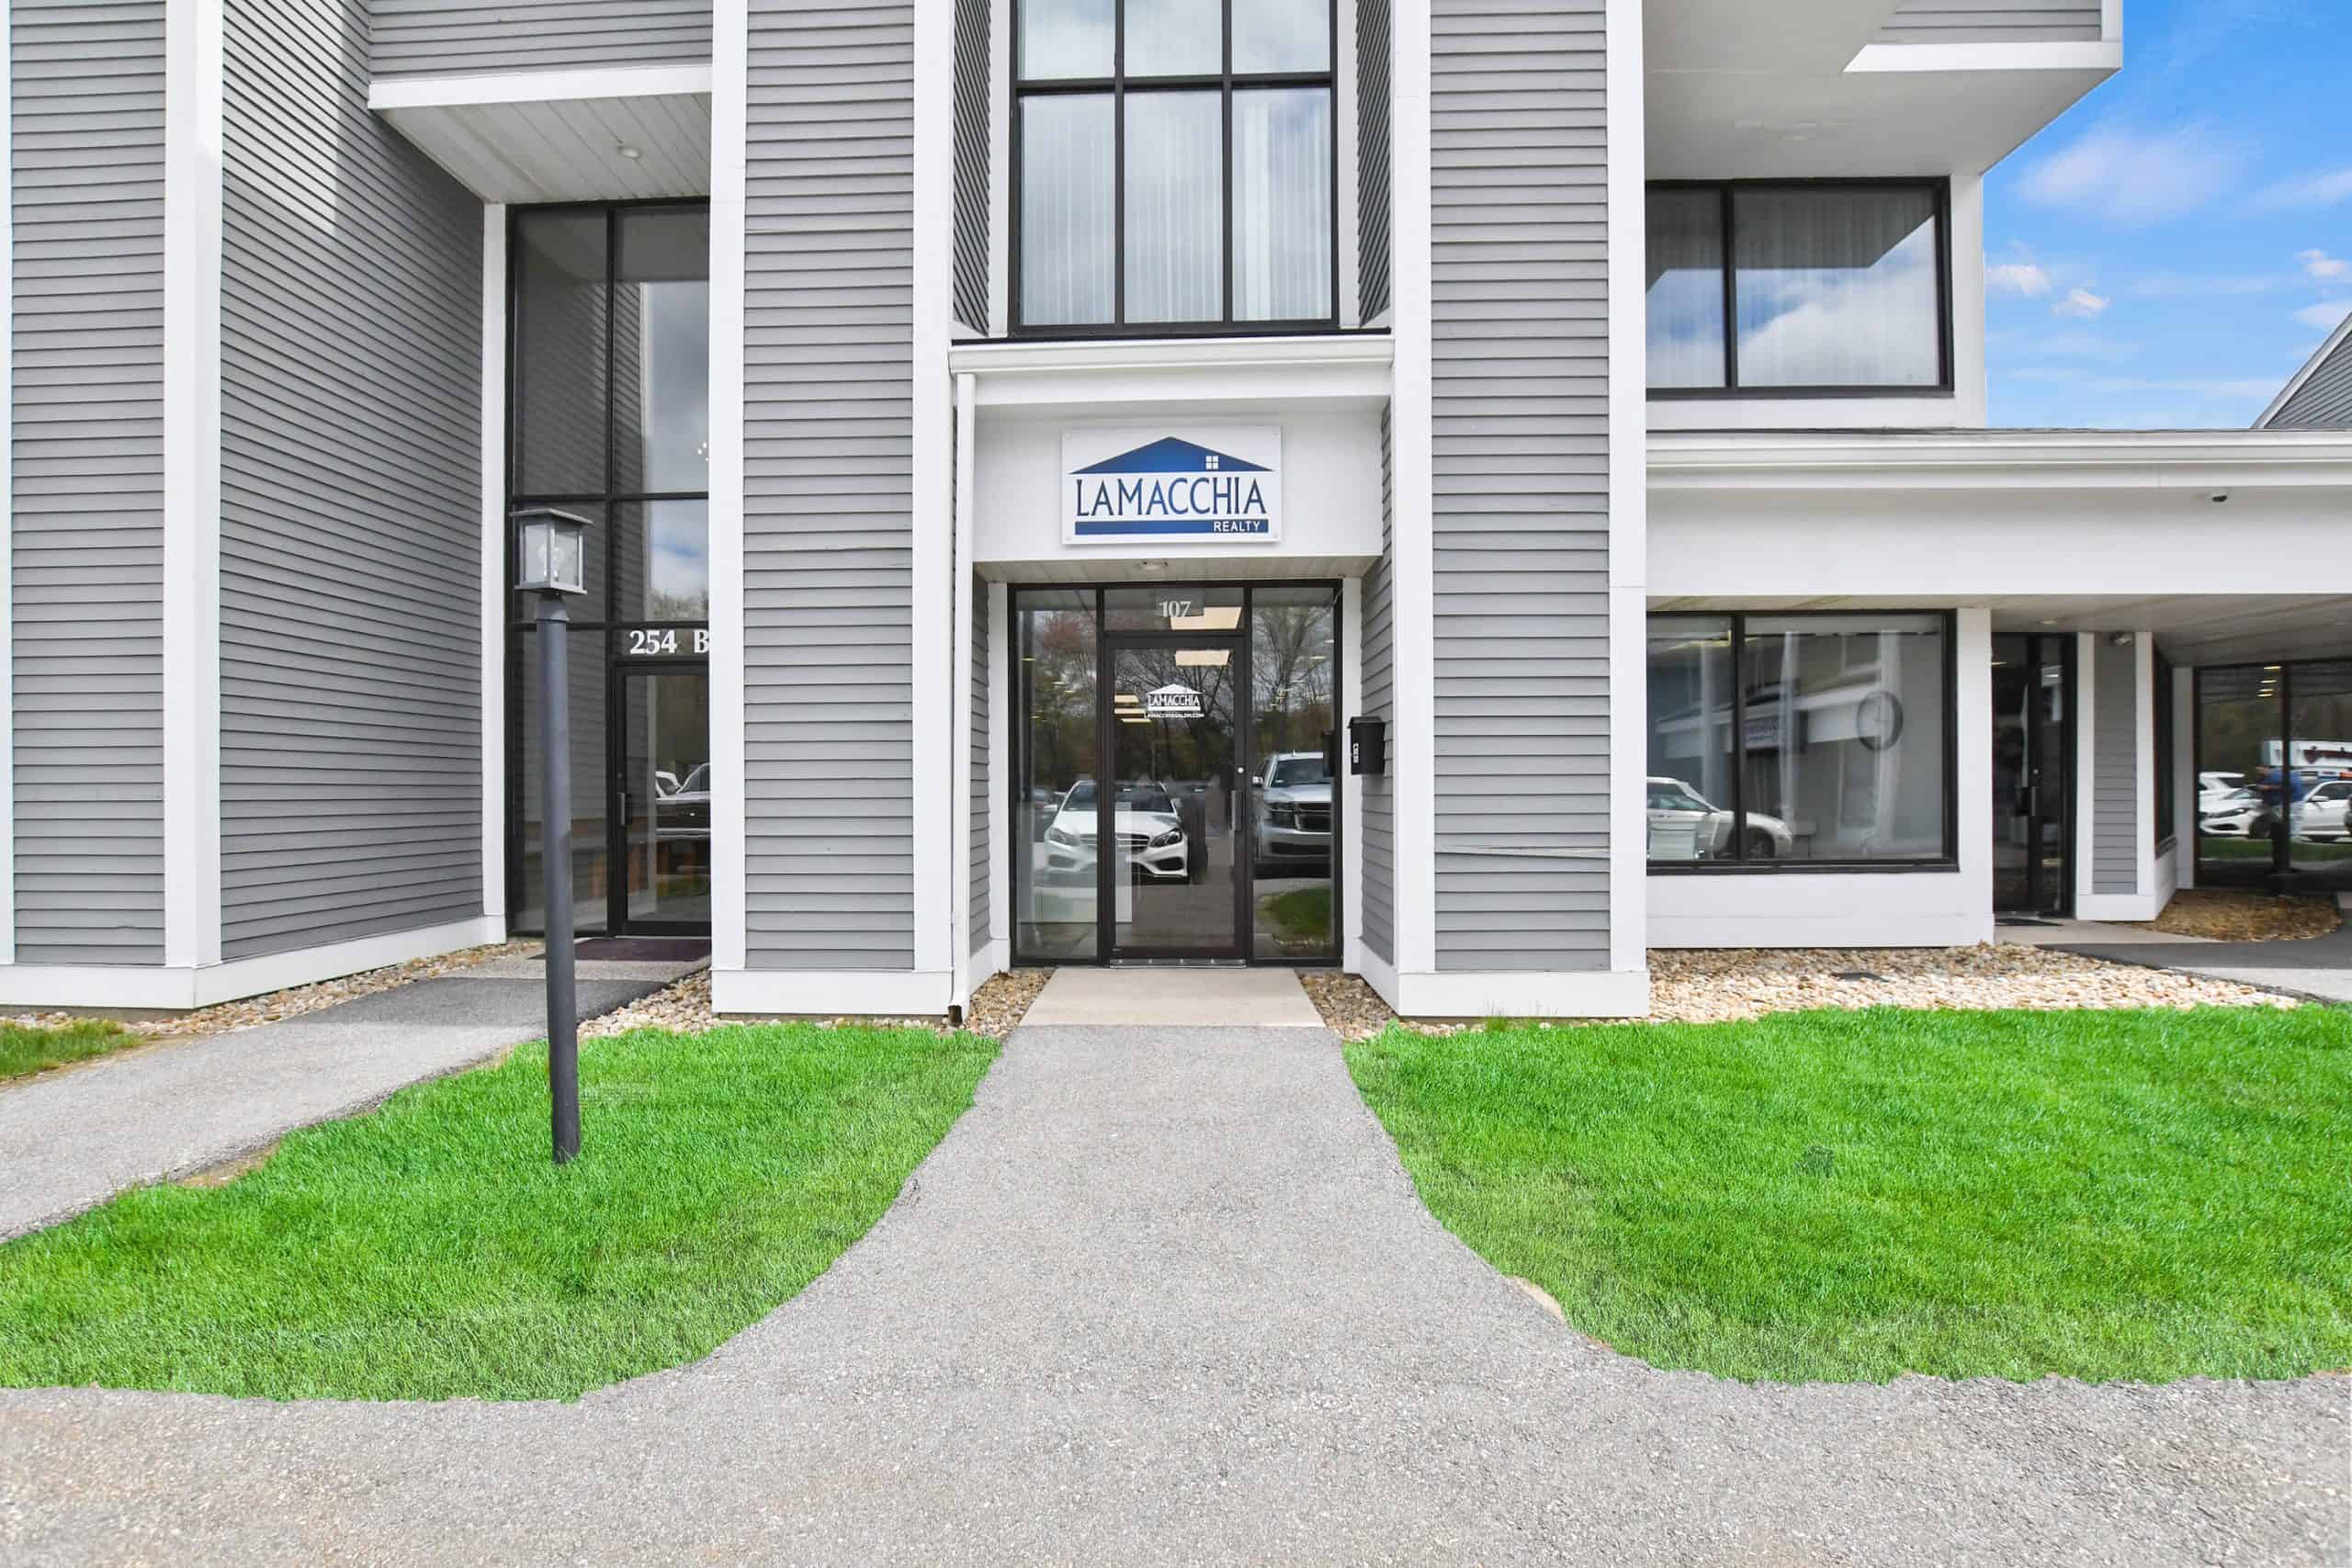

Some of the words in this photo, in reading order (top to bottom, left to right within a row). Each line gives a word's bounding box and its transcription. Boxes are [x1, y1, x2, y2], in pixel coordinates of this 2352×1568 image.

[1076, 477, 1267, 516] LAMACCHIA
[1214, 521, 1261, 533] REALTY
[1159, 601, 1192, 617] 107
[629, 629, 677, 654] 254
[694, 629, 709, 653] B
[1148, 694, 1200, 705] LAMACCHIA
